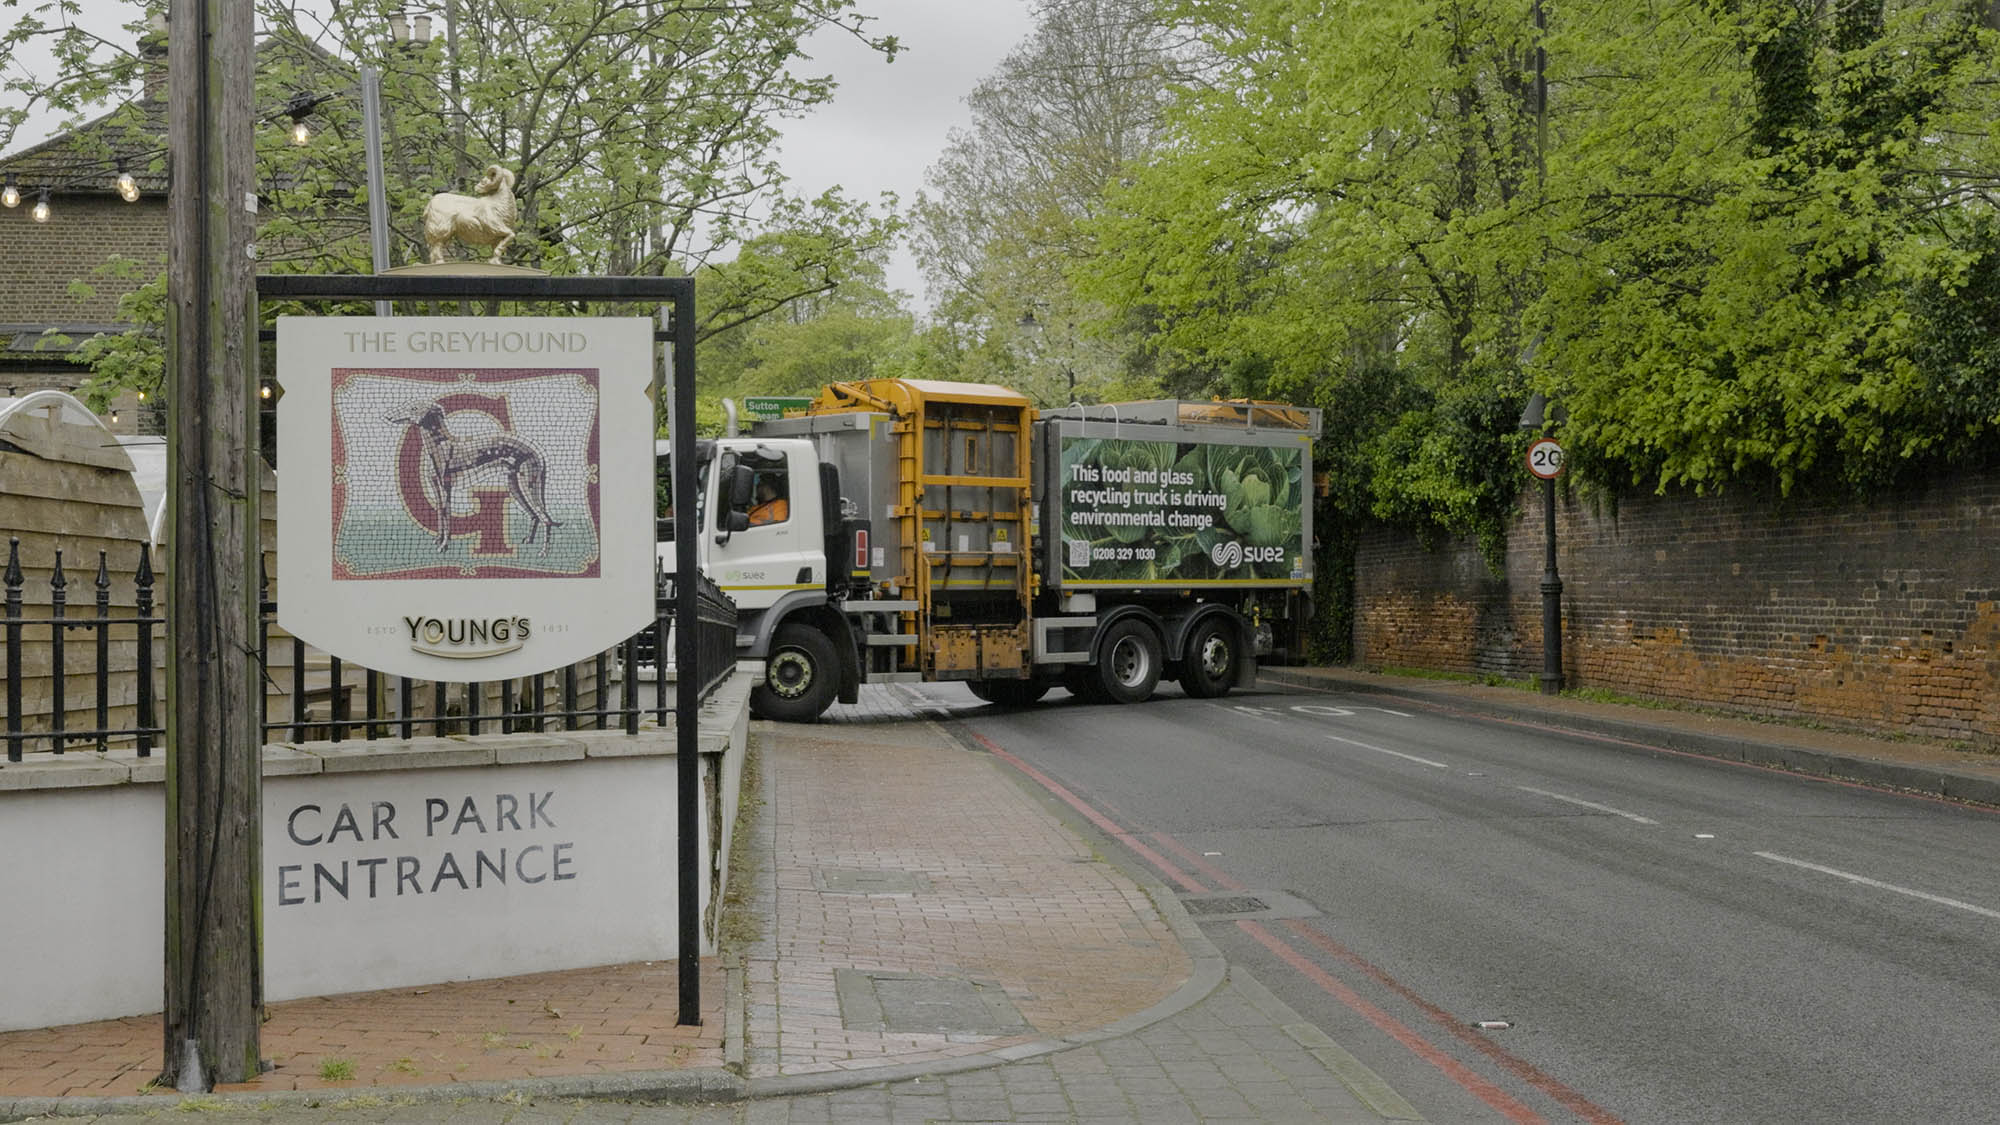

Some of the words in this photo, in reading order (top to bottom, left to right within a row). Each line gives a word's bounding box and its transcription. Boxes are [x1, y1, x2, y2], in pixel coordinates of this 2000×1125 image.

[344, 331, 397, 353] THE
[407, 331, 588, 353] GREYHOUND
[748, 401, 780, 411] Sutton
[1533, 450, 1562, 467] 20
[1071, 464, 1099, 482] This
[1102, 465, 1131, 484] food
[1133, 467, 1158, 484] and
[1160, 468, 1194, 488] glass
[1071, 487, 1131, 508] recycling
[1134, 489, 1168, 506] truck
[1171, 490, 1182, 506] is
[1184, 490, 1227, 510] driving
[1071, 509, 1166, 527] environmental
[1168, 510, 1213, 531] change
[1093, 548, 1115, 561] 0208
[1117, 548, 1133, 561] 329
[1135, 548, 1156, 561] 1030
[1244, 546, 1284, 562] suez
[403, 615, 531, 645] YOUNG'S
[287, 799, 400, 846] CAR
[425, 791, 557, 837] PARK
[278, 842, 577, 906] ENTRANCE
